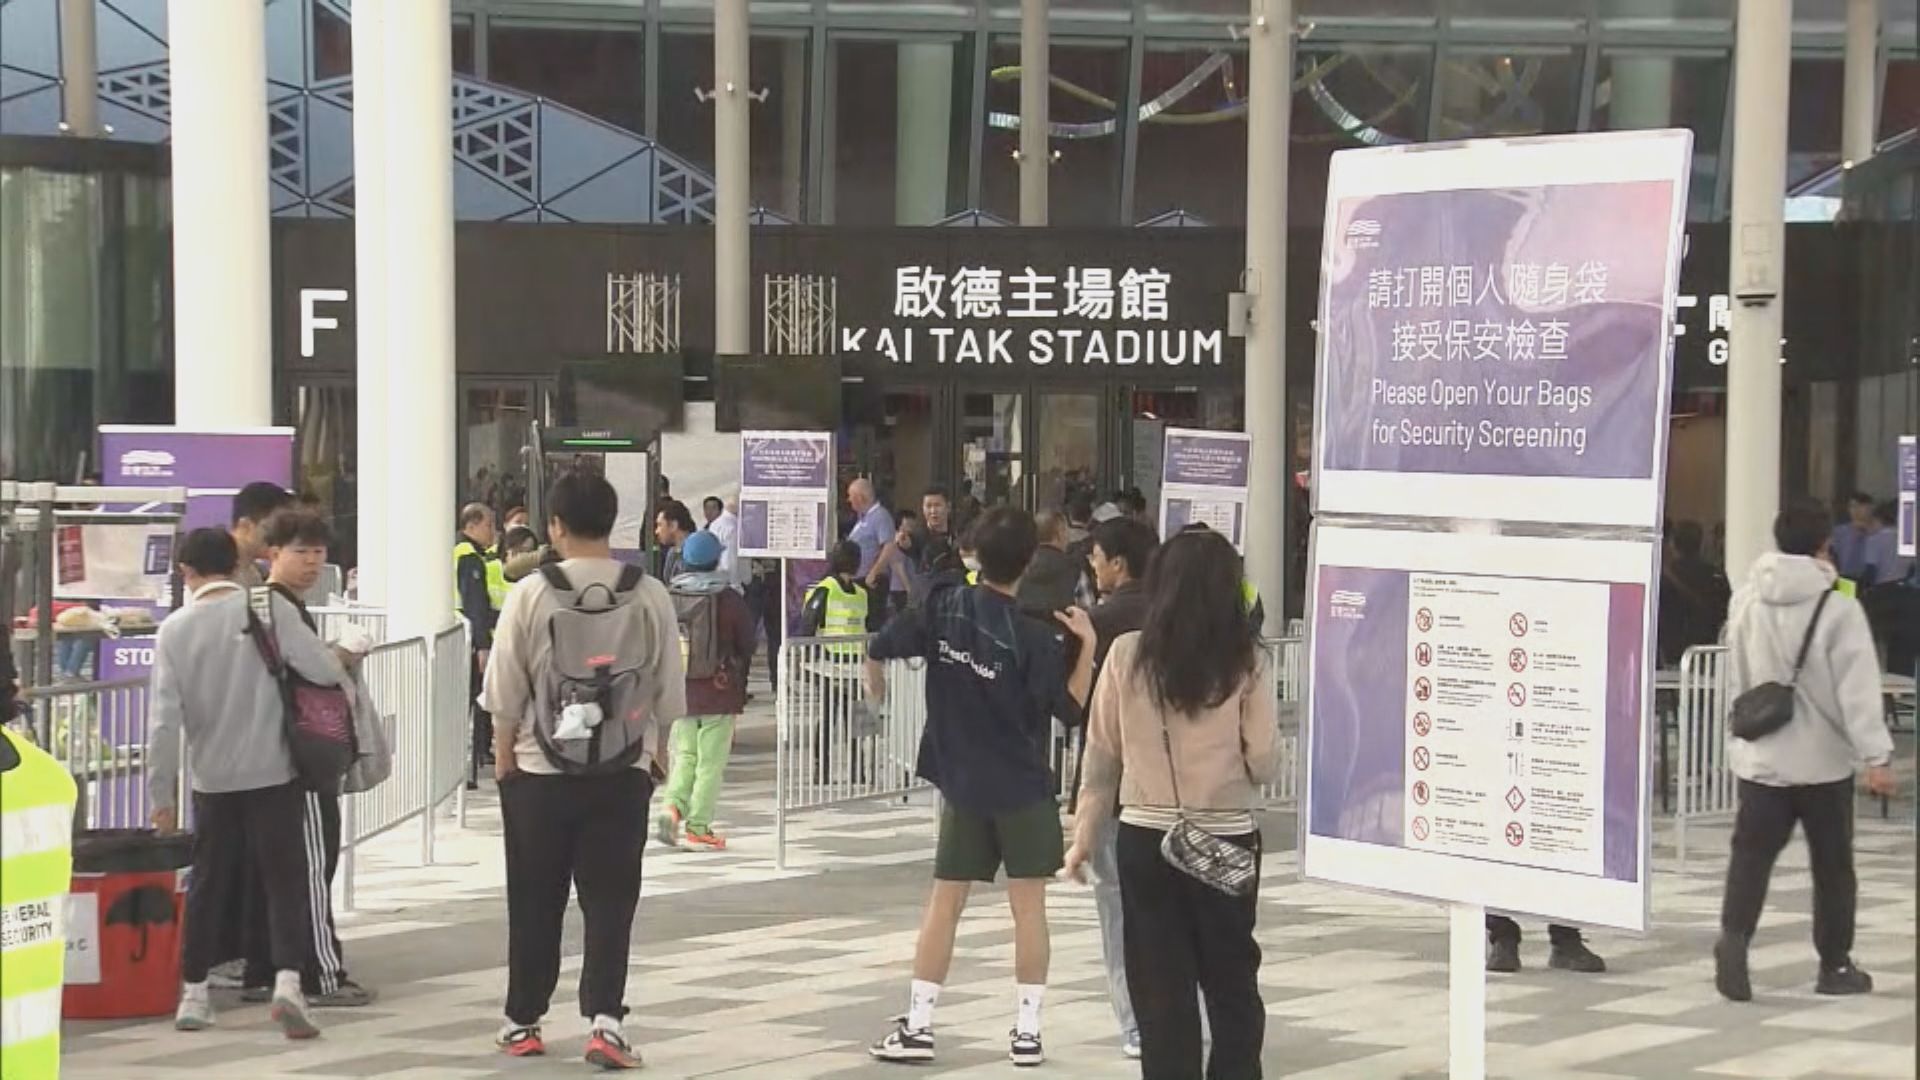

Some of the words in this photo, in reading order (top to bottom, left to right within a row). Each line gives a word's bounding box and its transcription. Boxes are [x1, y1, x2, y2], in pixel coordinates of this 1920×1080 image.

[893, 265, 1171, 321] 啟德主場館
[1368, 260, 1609, 309] 請打開個人隨身袋
[300, 288, 348, 358] F
[1392, 317, 1571, 362] 接受保安檢查
[842, 327, 913, 363] KAI
[929, 327, 1014, 364] TAK
[1028, 328, 1223, 366] STADIUM
[1371, 378, 1427, 406] Please
[1431, 378, 1479, 411] Open
[1483, 378, 1533, 407] Your
[1537, 379, 1593, 413] Bags
[1372, 418, 1398, 445] for
[1400, 418, 1475, 452] Security
[1478, 420, 1587, 455] Screening
